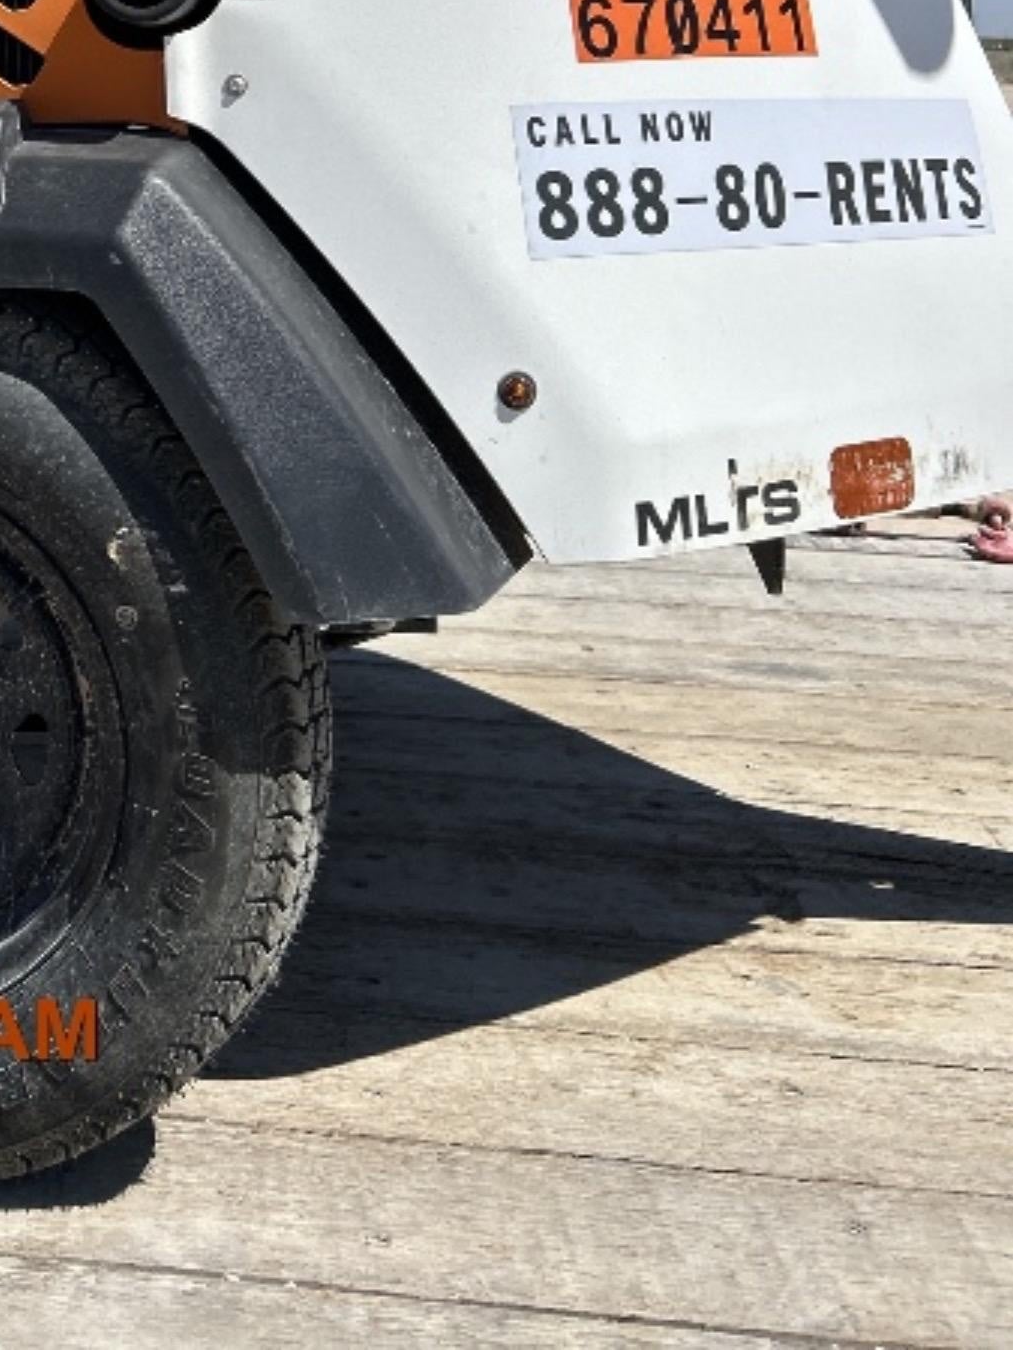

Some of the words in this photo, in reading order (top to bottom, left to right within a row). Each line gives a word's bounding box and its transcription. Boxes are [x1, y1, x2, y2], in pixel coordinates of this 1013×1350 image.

[526, 113, 621, 147] CALL
[640, 111, 712, 143] NOW
[536, 157, 983, 241] 888-80-RENTS
